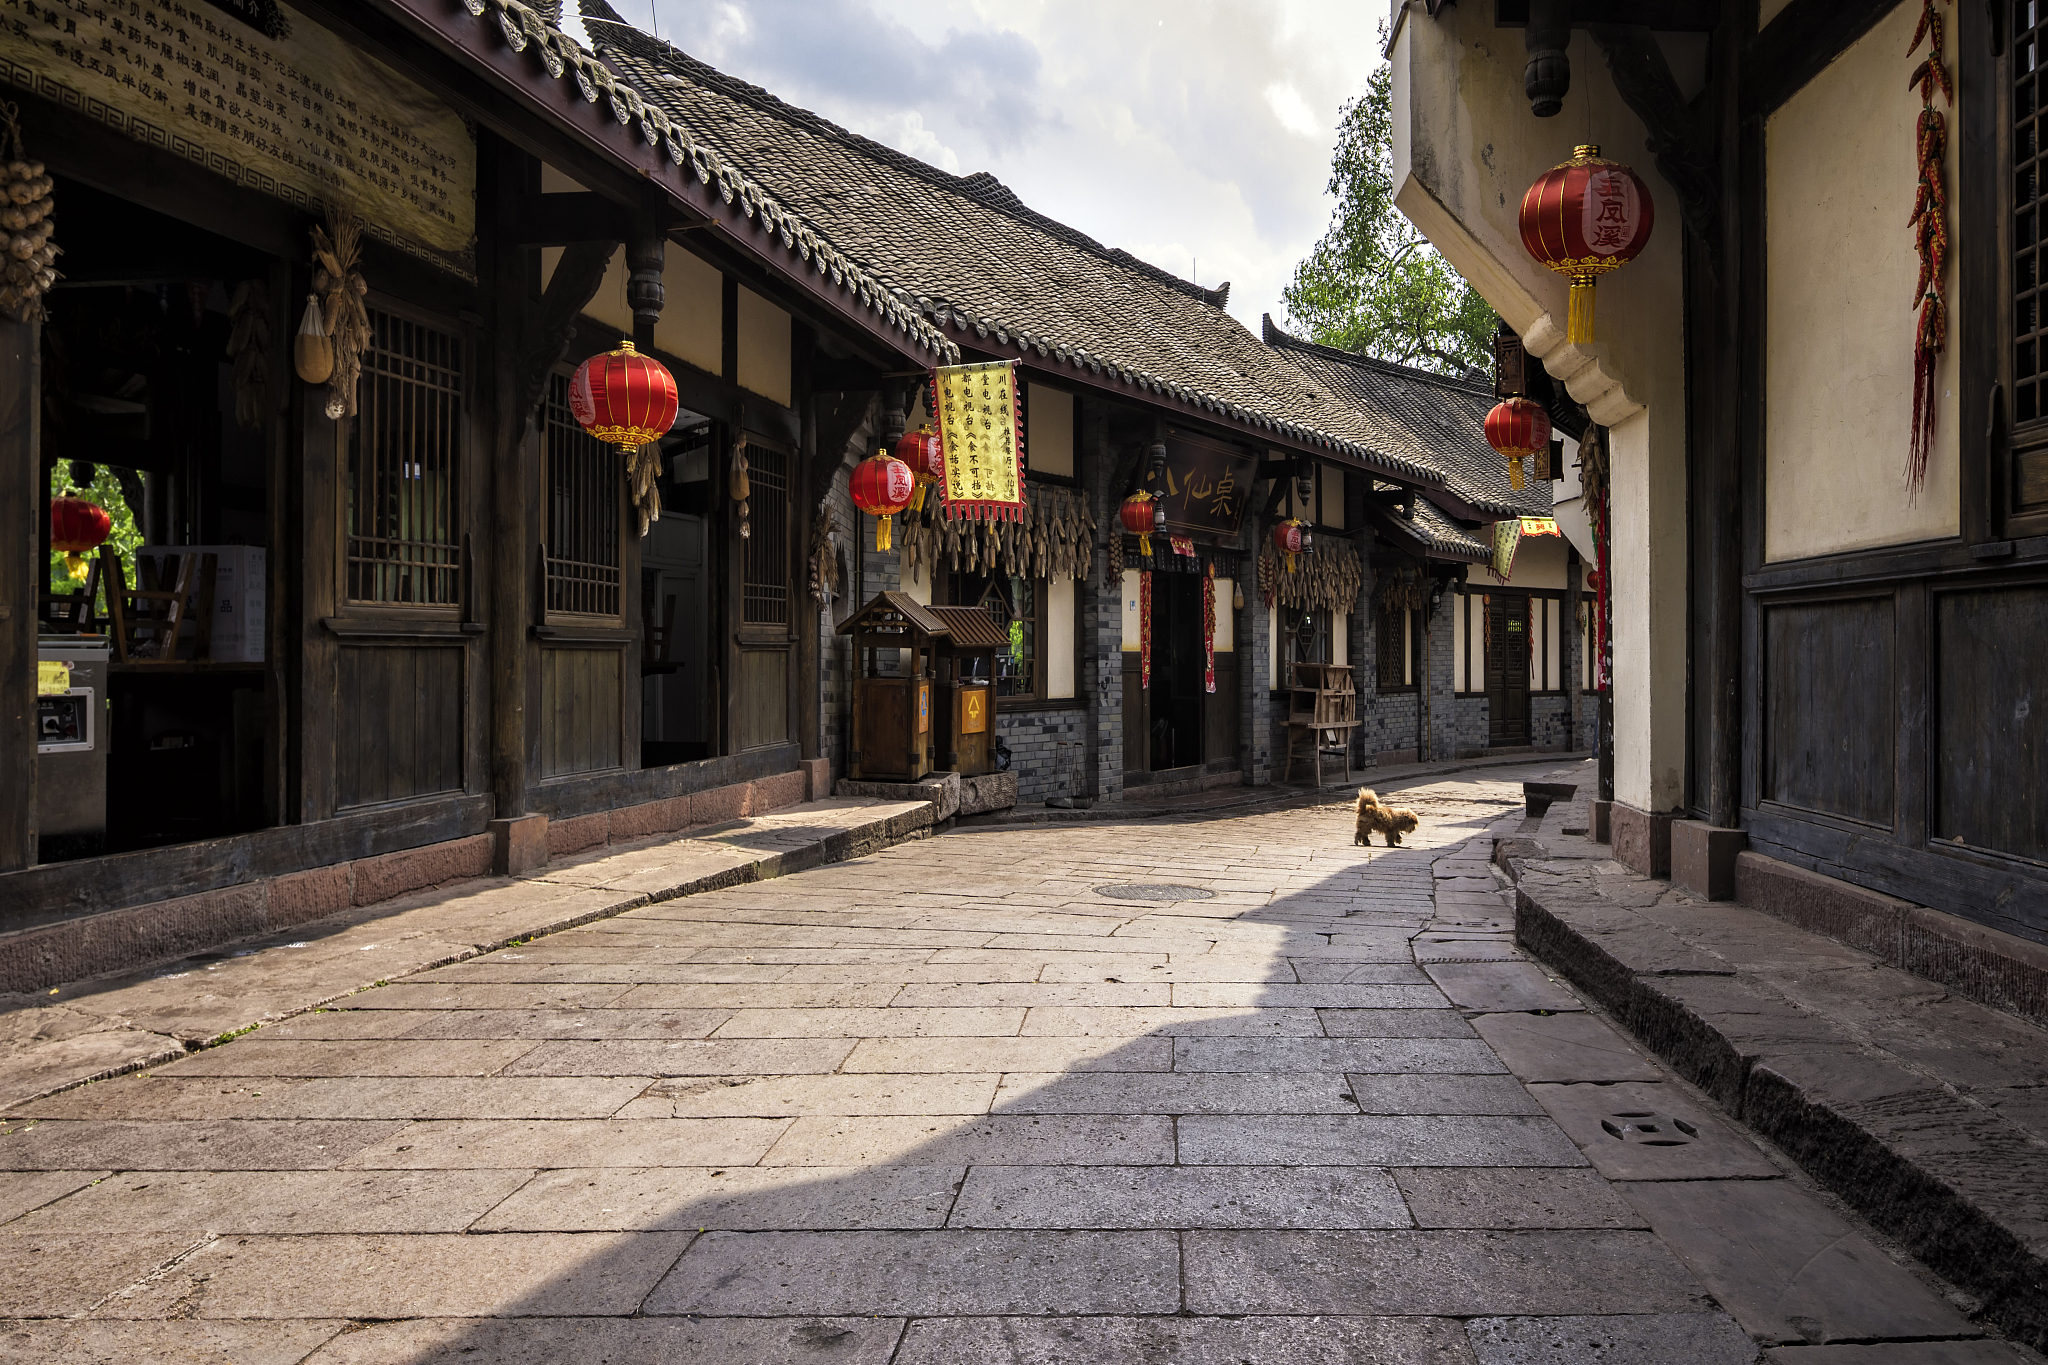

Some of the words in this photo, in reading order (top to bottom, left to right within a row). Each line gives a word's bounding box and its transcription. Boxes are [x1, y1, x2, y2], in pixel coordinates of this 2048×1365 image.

[942, 366, 964, 499] 川电视台《食话实说》
[1147, 464, 1235, 517] 八仙桌
